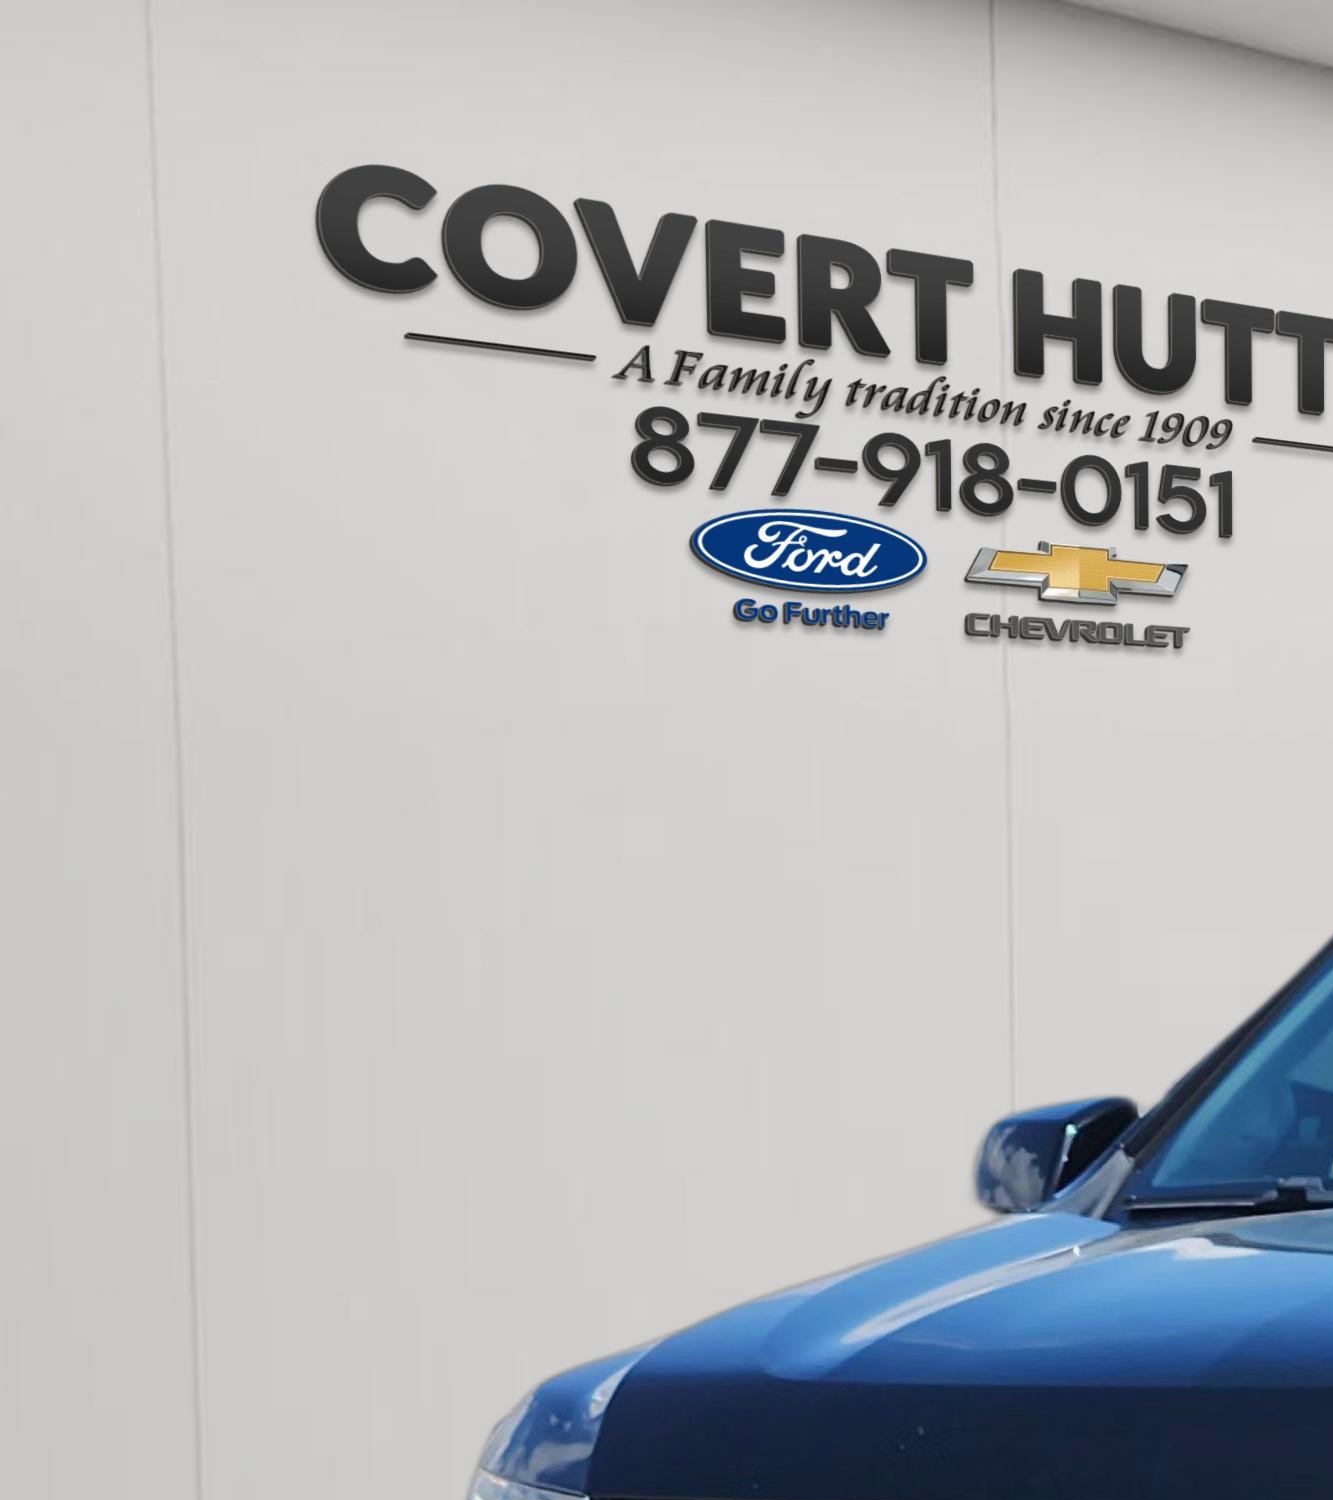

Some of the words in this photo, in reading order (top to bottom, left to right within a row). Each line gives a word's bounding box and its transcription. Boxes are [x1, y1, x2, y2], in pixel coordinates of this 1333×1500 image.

[315, 164, 974, 367] COVERT
[612, 345, 655, 384] A
[664, 349, 834, 420] Family
[846, 376, 1027, 427] tradition
[1037, 400, 1131, 439] since
[1139, 410, 1234, 450] 1909
[630, 406, 1233, 540] 877-918-0151
[742, 520, 882, 580] Ford
[732, 598, 779, 625] Go
[782, 600, 890, 631] Further
[964, 612, 1190, 650] CHEVROLET
